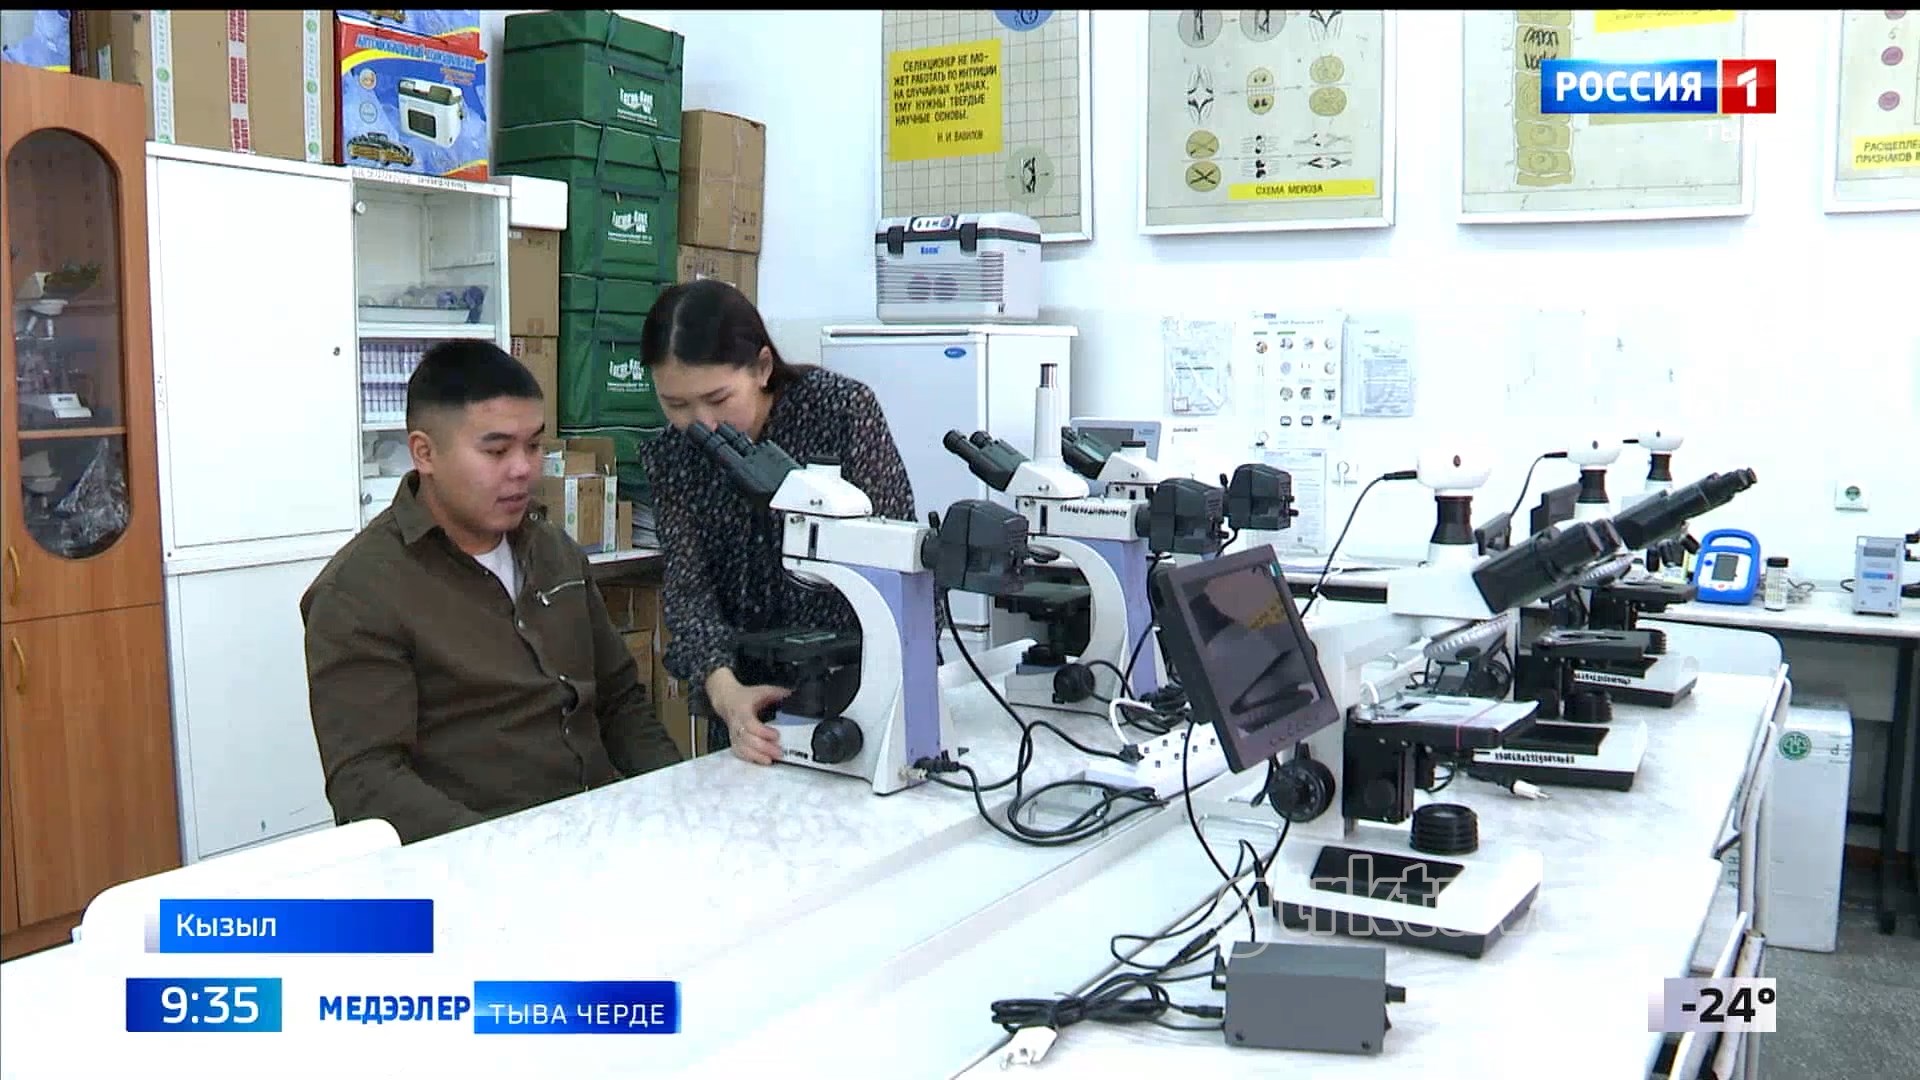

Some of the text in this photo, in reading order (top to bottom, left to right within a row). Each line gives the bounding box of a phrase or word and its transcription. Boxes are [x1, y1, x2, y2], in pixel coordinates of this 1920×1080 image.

[903, 52, 989, 72] СЕЛЕКЦИОНЕР НЕ МО-
[894, 75, 909, 86] ЖЕТ
[912, 71, 946, 84] РАБОТАТЬ
[948, 69, 957, 81] ПО
[894, 88, 904, 100] НА
[906, 83, 950, 97] СЛУЧАЙНЫХ
[895, 93, 985, 112] ЕМУ НУЖНЫ ТВЕРДЫЕ
[895, 113, 930, 126] НАУЧНЫЕ
[1856, 152, 1912, 164] ПРИЗНАКОВ
[1255, 185, 1285, 196] СХЕМА
